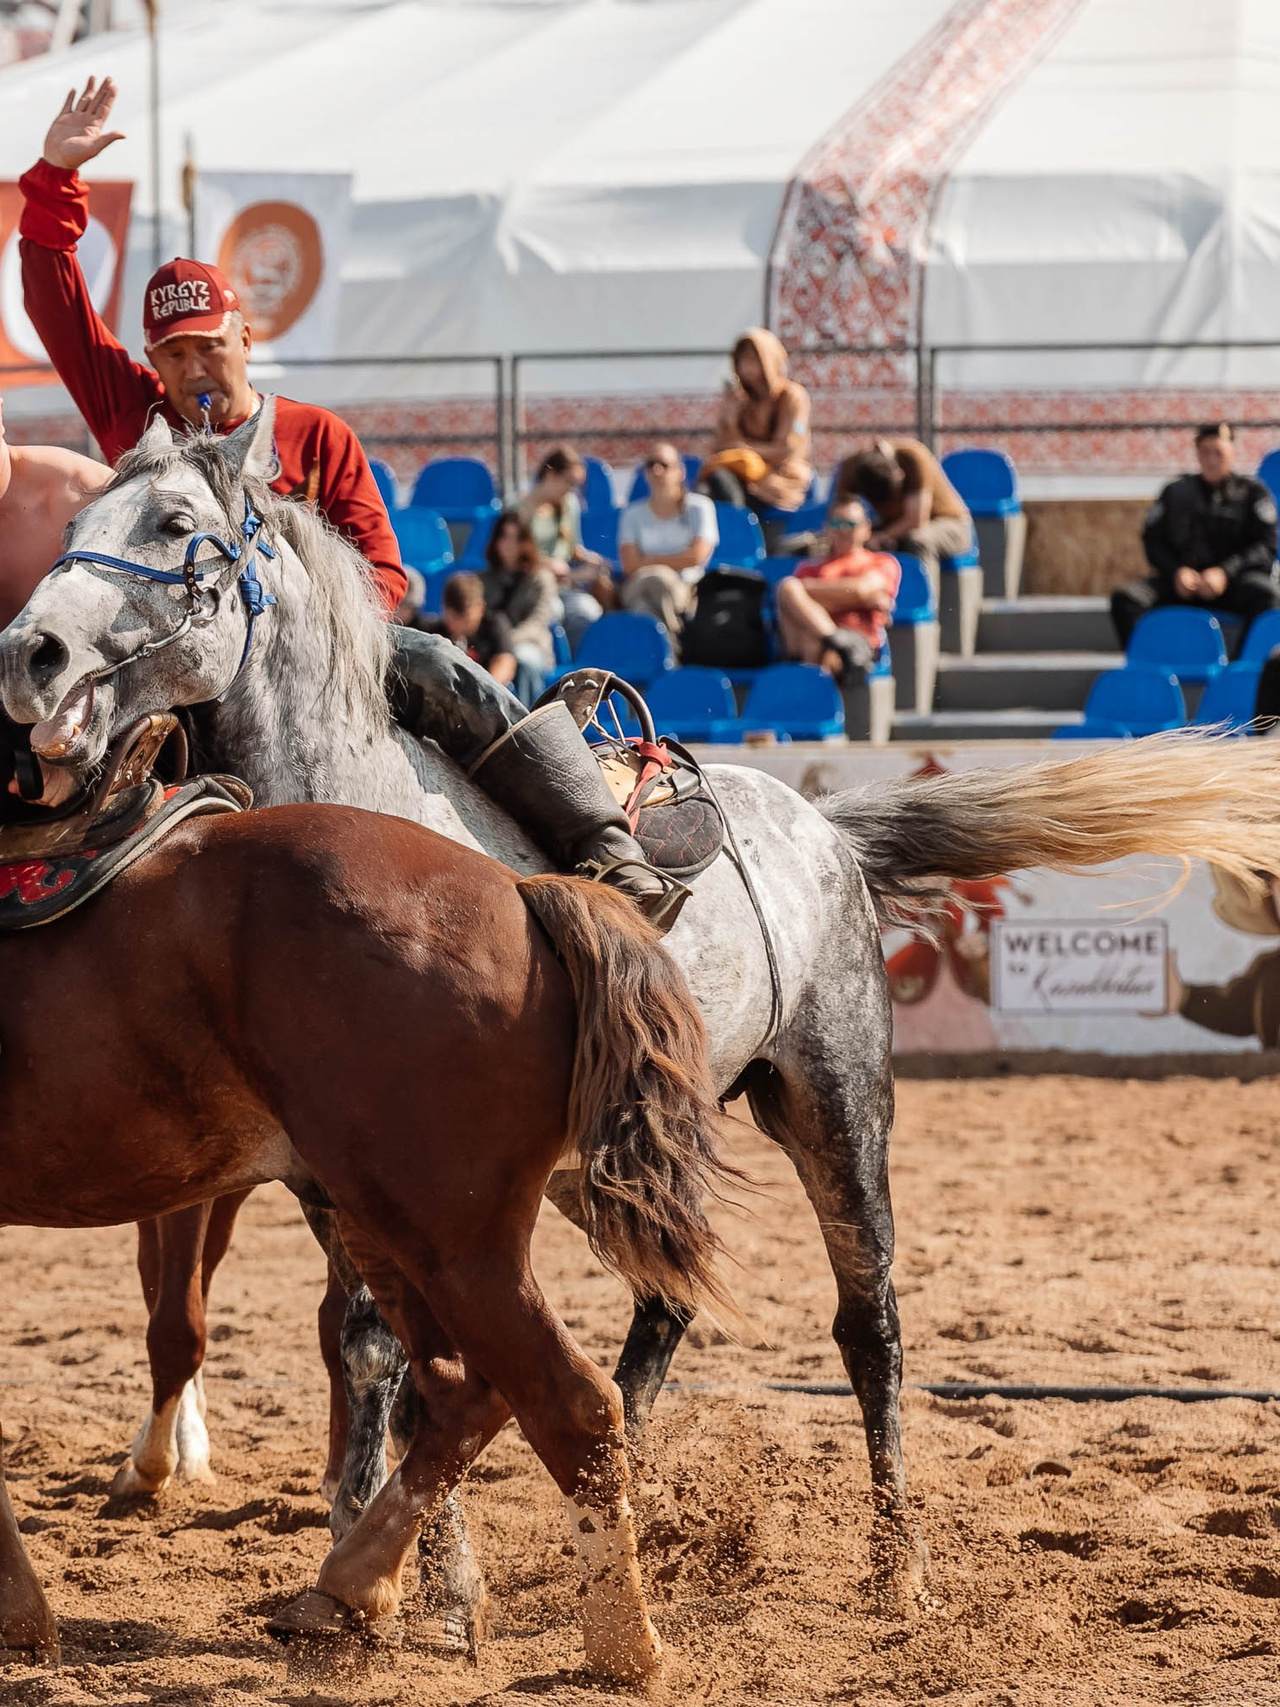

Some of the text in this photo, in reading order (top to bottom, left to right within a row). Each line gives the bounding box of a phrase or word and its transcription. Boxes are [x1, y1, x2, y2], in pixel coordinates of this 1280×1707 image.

[150, 280, 210, 306] KYRGYZ
[152, 296, 211, 320] REPUBLIC
[1005, 930, 1158, 956] WELCOME
